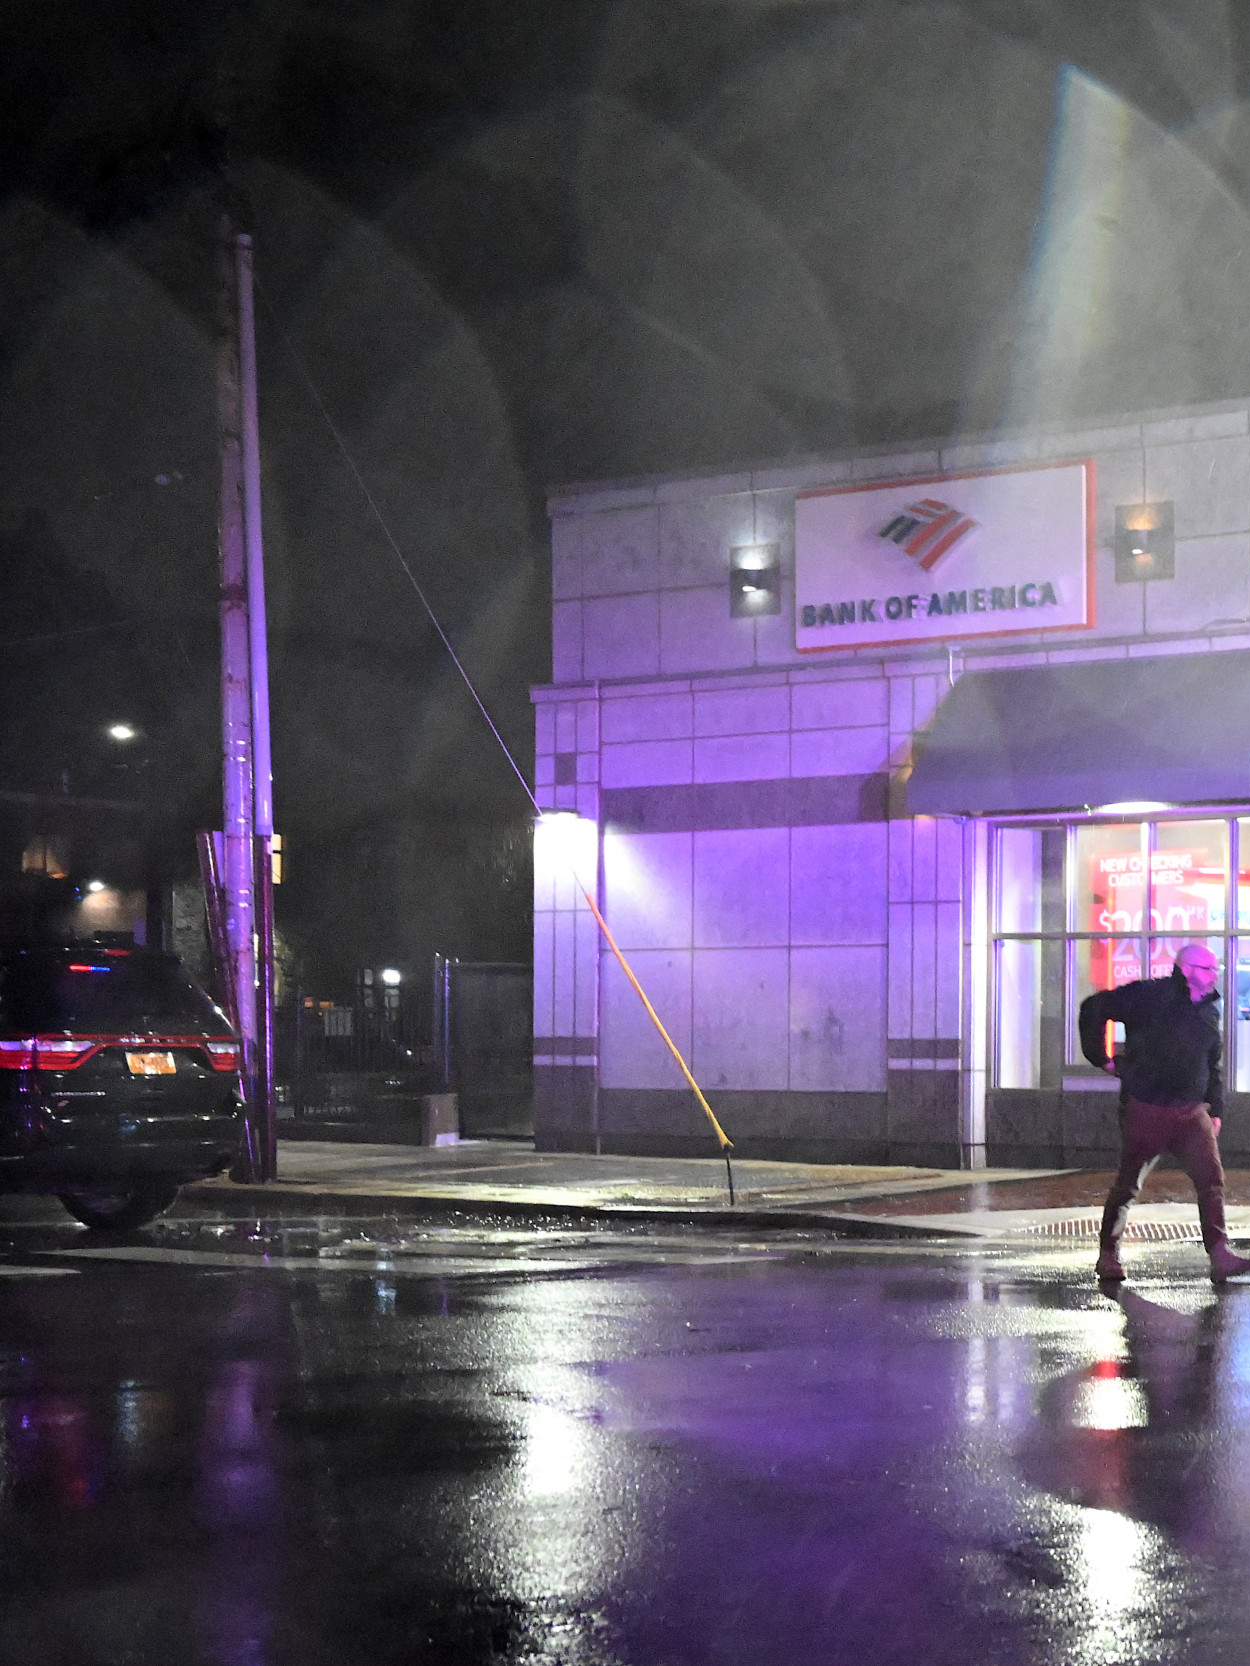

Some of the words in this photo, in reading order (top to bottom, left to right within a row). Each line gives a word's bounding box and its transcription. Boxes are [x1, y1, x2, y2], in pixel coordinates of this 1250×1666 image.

[802, 599, 877, 628] BANK
[885, 594, 920, 620] OF
[926, 581, 1059, 617] AMERICA
[1100, 857, 1127, 873] NEW
[1114, 964, 1142, 978] CASH
